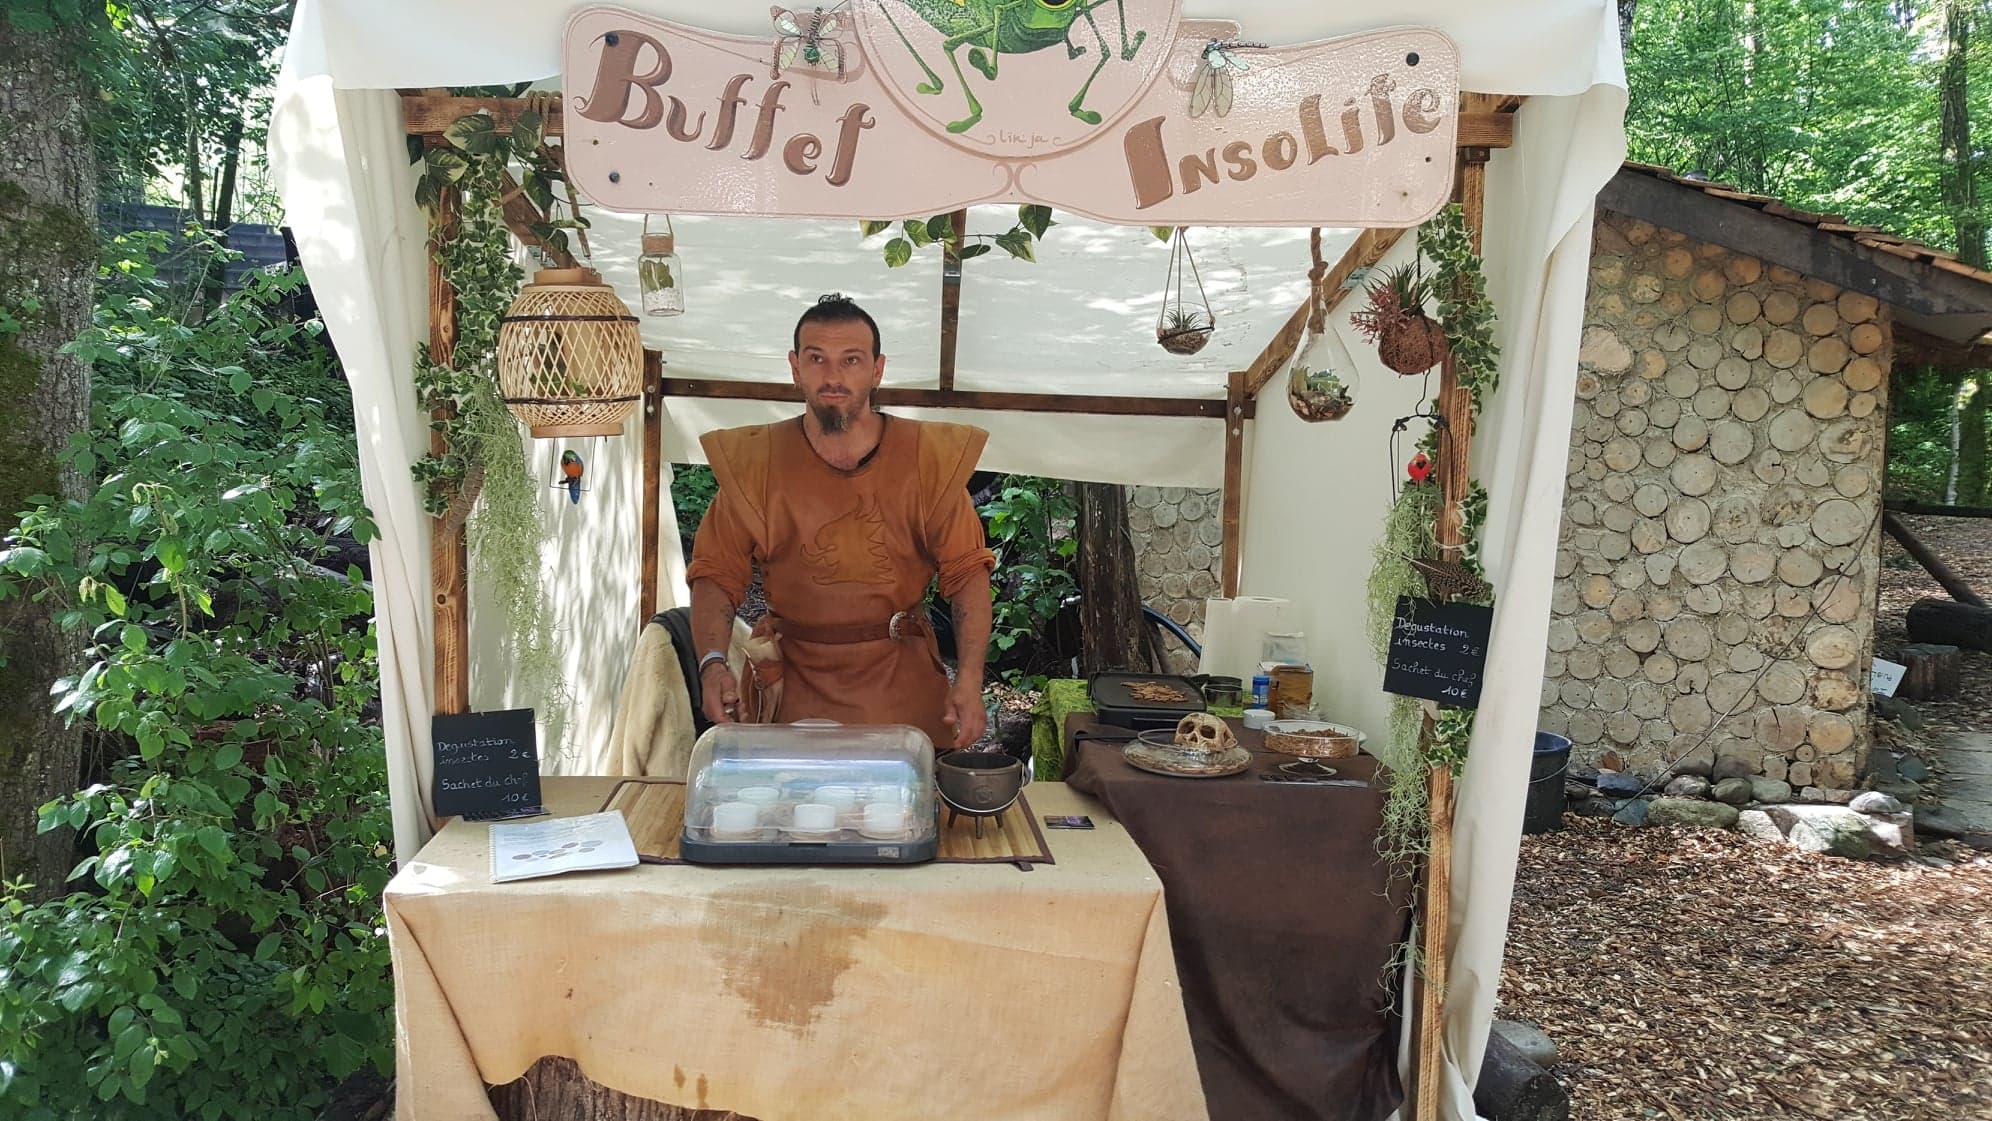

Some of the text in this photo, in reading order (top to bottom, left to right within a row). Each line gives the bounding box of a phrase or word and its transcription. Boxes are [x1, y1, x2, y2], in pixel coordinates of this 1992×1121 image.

[574, 30, 876, 187] Buffet
[1392, 657, 1432, 675] Sachet
[1434, 668, 1449, 679] du
[442, 777, 483, 790] Sachet
[485, 776, 501, 788] du
